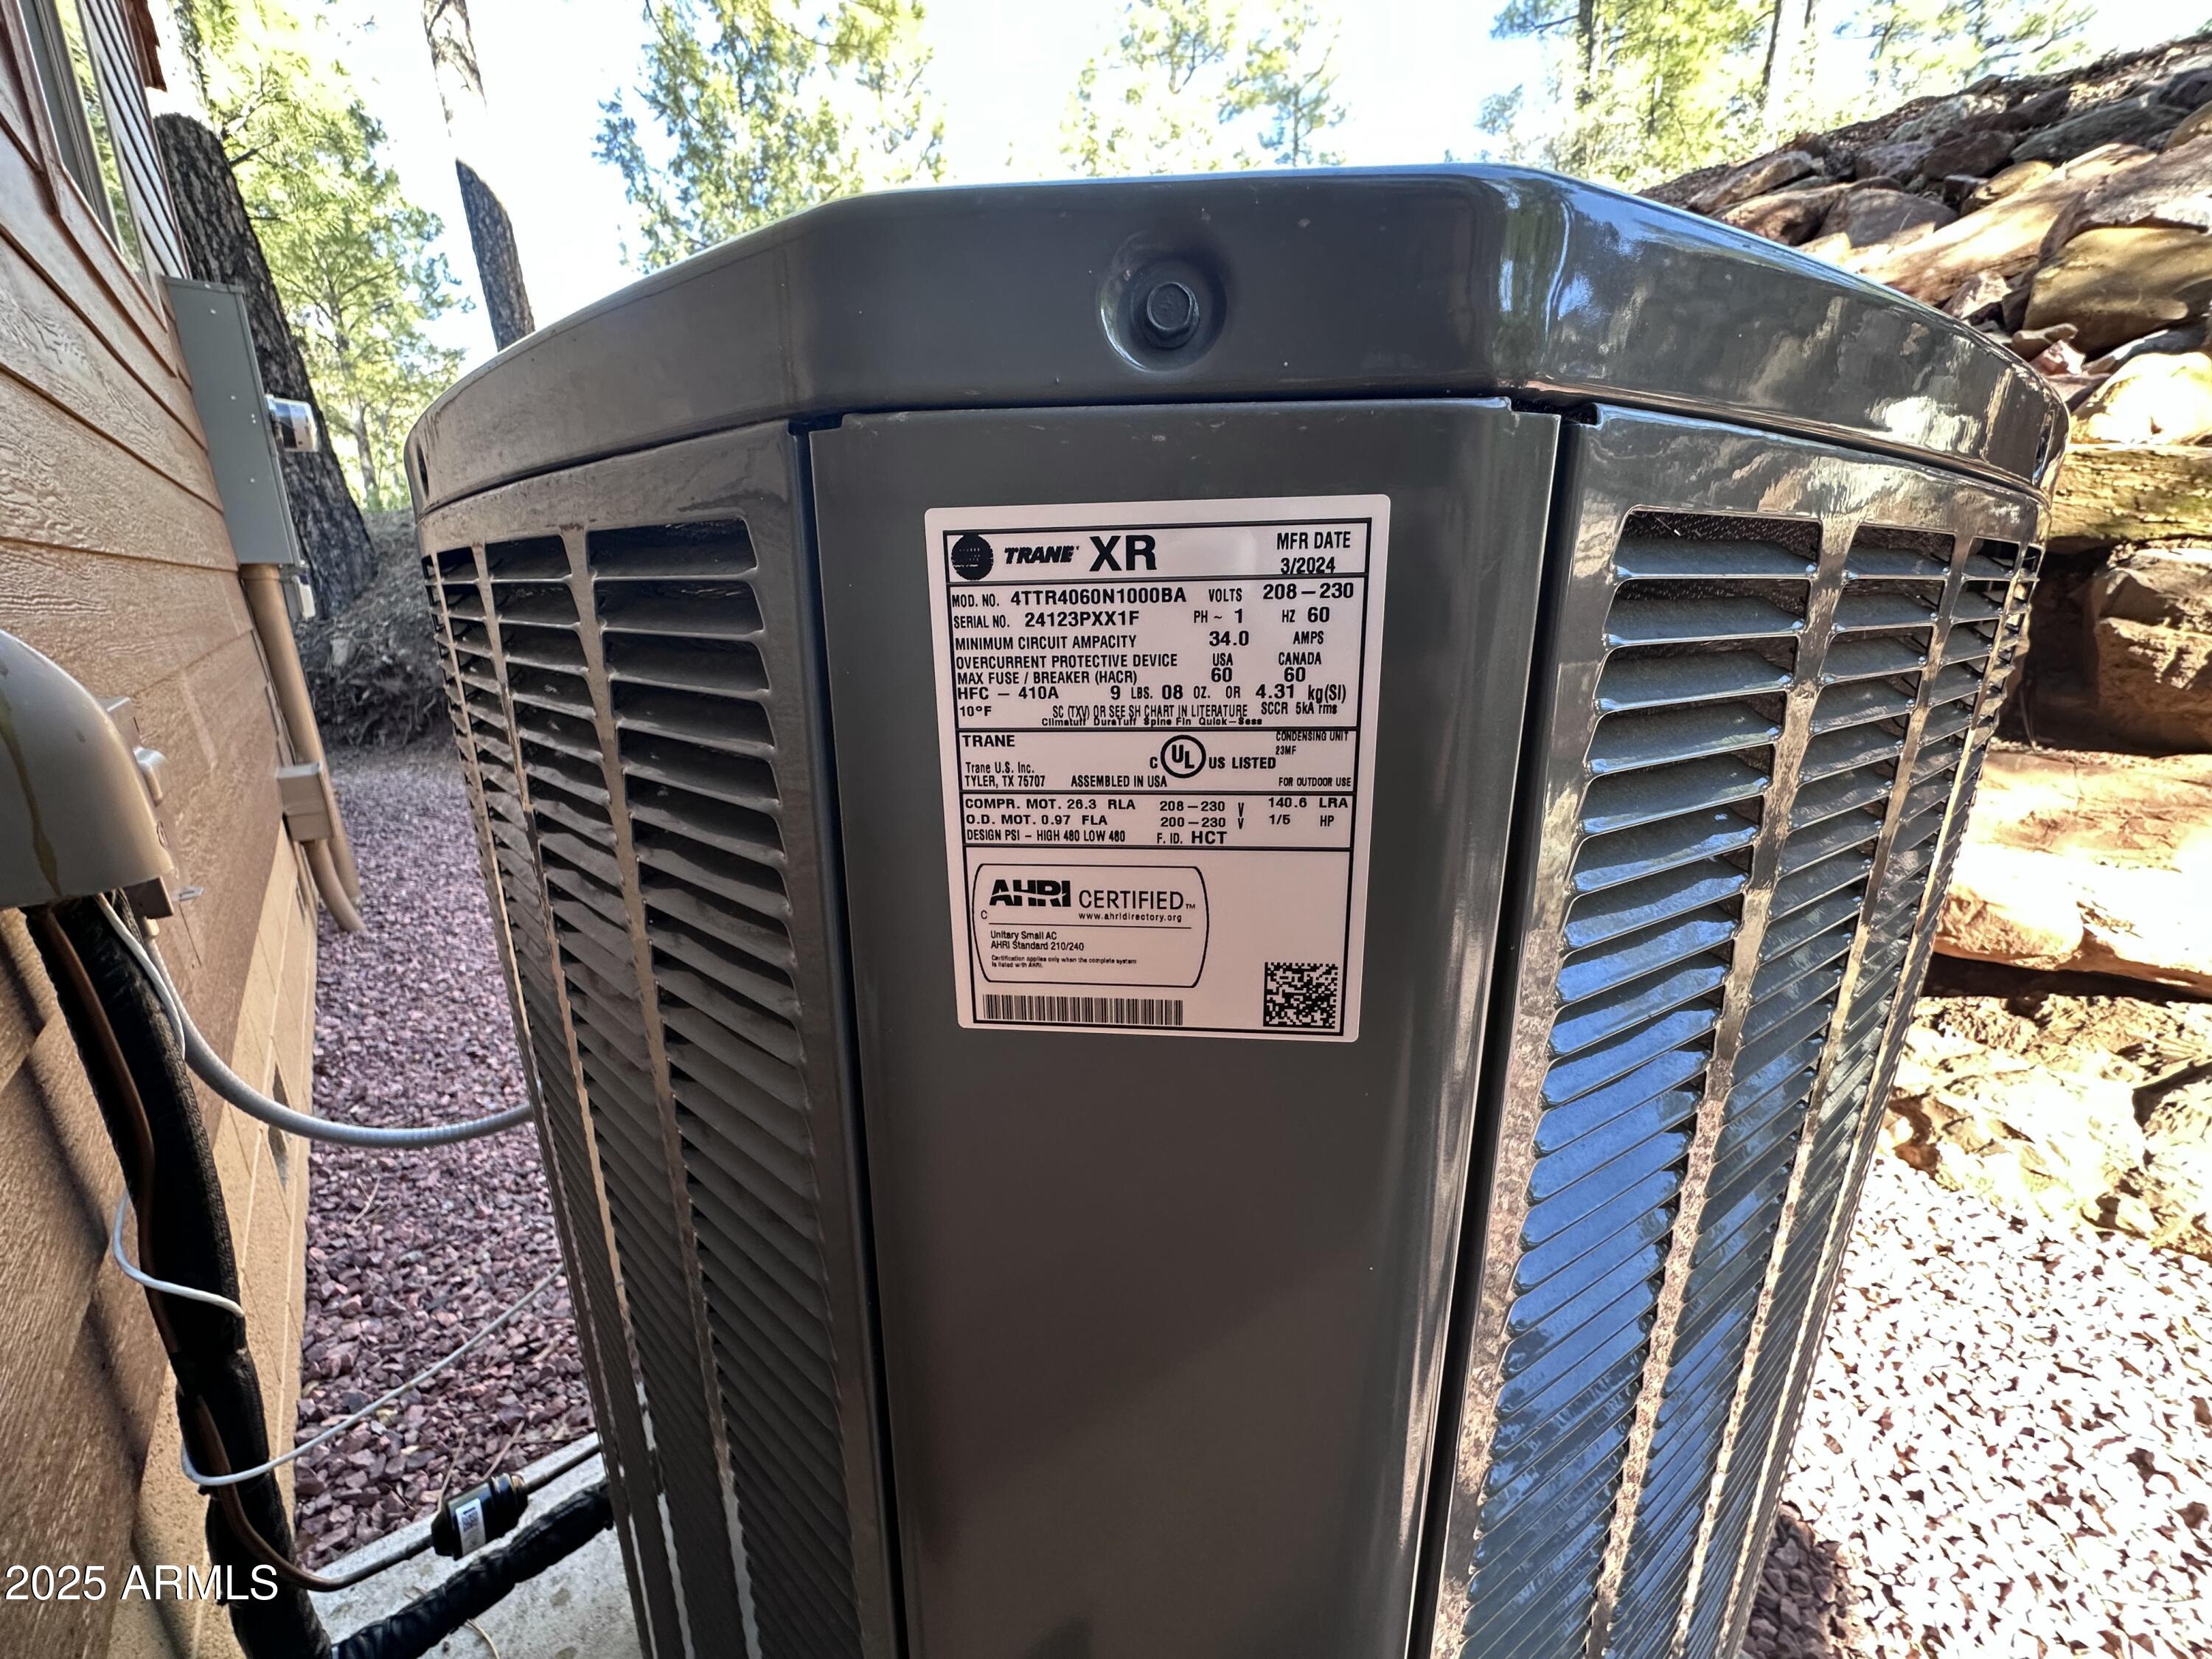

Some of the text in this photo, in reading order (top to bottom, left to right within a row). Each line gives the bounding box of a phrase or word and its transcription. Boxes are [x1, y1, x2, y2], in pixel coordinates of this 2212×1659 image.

[1276, 531, 1351, 550] MFR DATE
[1004, 534, 1158, 572] TRANE XR
[1280, 557, 1336, 574] 3/2024
[952, 587, 1186, 608] MOD. NO. 4TTR4060N1000BA
[1208, 588, 1242, 602] VOLTS
[953, 611, 1139, 628] SERIAL NO. 24123PXX1F
[1194, 610, 1208, 623] PH
[1234, 608, 1242, 623] 1
[1281, 606, 1330, 622] HZ 60
[956, 635, 1137, 650] MINIMUM CIRCUIT AMPACITY
[1208, 630, 1250, 646] 34.0
[1293, 631, 1324, 644] AMPS
[956, 653, 1178, 669] OVERCURRENT PROTECTIVE DEVICE
[1212, 653, 1234, 666] USA
[1278, 652, 1322, 665] CANADA
[958, 670, 1138, 685] MAX FUSE / BREAKER (HACR)
[1211, 667, 1233, 682] 60
[1284, 667, 1306, 682] 60
[958, 686, 989, 700] HFC
[1018, 686, 1059, 699] 410A
[1110, 684, 1346, 703] 9 LBS. 08 OZ. OR 4.31 kg(SI)
[1052, 704, 1248, 720] SC (TXV) OR SEE SH CHART IN LITERATURE
[1261, 701, 1338, 714] SCCR 5kA rms
[1144, 717, 1172, 727] Spine
[1176, 717, 1192, 726] Fin
[962, 735, 1015, 747] TRANE
[1276, 731, 1349, 741] CONDENSING UNIT
[1172, 745, 1194, 768] UL
[1276, 745, 1296, 755] 23MF
[965, 762, 1034, 773] Trane U.S. Inc.
[1150, 757, 1158, 768] C
[1209, 757, 1276, 768] US LISTED
[965, 775, 1045, 788] TYLER, TX 75707
[1071, 775, 1167, 787] ASSEMBLED IN USA
[1279, 777, 1351, 786] FOR OUTDOOR USE
[965, 799, 1136, 810] COMPR. MOT. 26.3 RLA
[1268, 797, 1349, 808] 140.6 LRA
[1238, 802, 1245, 817] V
[966, 814, 1107, 825] O.D. MOT. 0.97 FLA
[1238, 818, 1244, 829] V
[1269, 815, 1335, 827] 1/5 HP
[967, 830, 1001, 841] DESIGN
[1005, 830, 1020, 841] PSI
[1037, 830, 1060, 841] HIGH
[1063, 830, 1080, 842] 480
[1084, 831, 1105, 842] LOW
[1108, 831, 1125, 842] 480
[1157, 831, 1227, 844] F. ID. HCT
[989, 880, 1071, 907] AHRI
[1079, 890, 1184, 910] CERTIFIED
[1078, 912, 1182, 923] www.ahridirectory.org
[990, 931, 1057, 941] Unitary Small AC
[990, 941, 1085, 950] AHRI Standard 210/240
